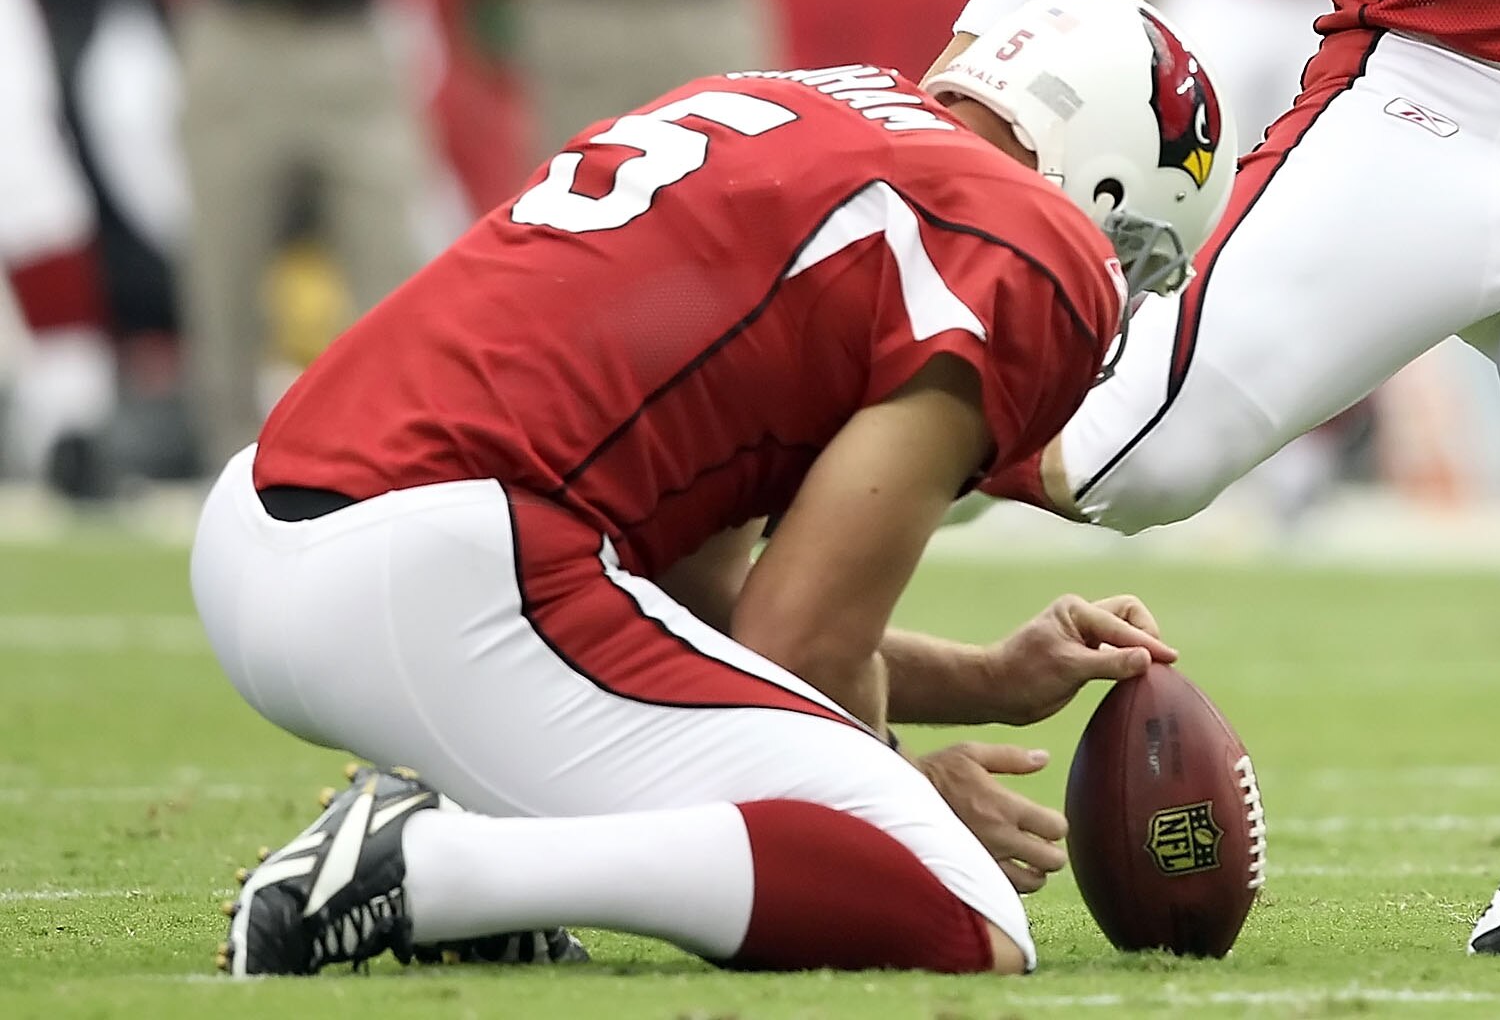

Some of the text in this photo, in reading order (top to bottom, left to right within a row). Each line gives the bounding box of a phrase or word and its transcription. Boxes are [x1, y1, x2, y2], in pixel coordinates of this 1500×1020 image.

[995, 29, 1035, 62] 5
[510, 90, 799, 233] 5
[1155, 814, 1192, 868] NFL
